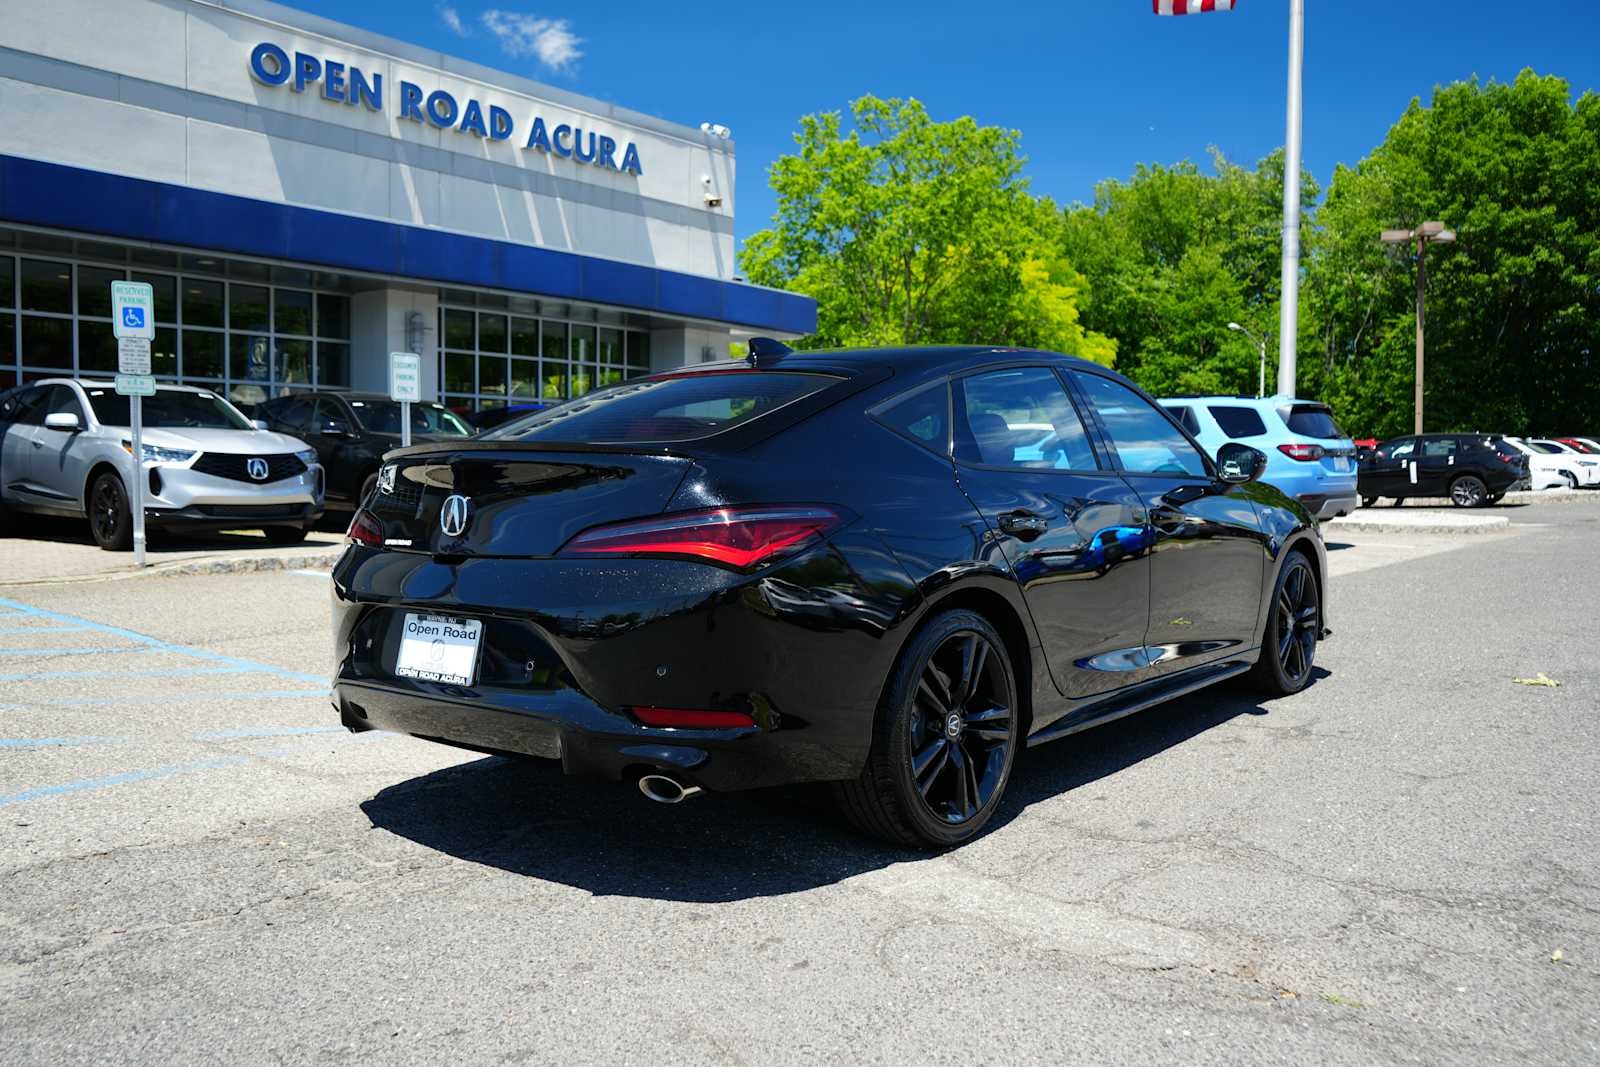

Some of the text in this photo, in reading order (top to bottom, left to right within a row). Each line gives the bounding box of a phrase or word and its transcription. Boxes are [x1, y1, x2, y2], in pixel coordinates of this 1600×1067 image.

[249, 42, 643, 175] OPEN ROAD ACURA
[408, 622, 477, 639] Open Road
[399, 668, 467, 686] OPEN ROAD ACURA
